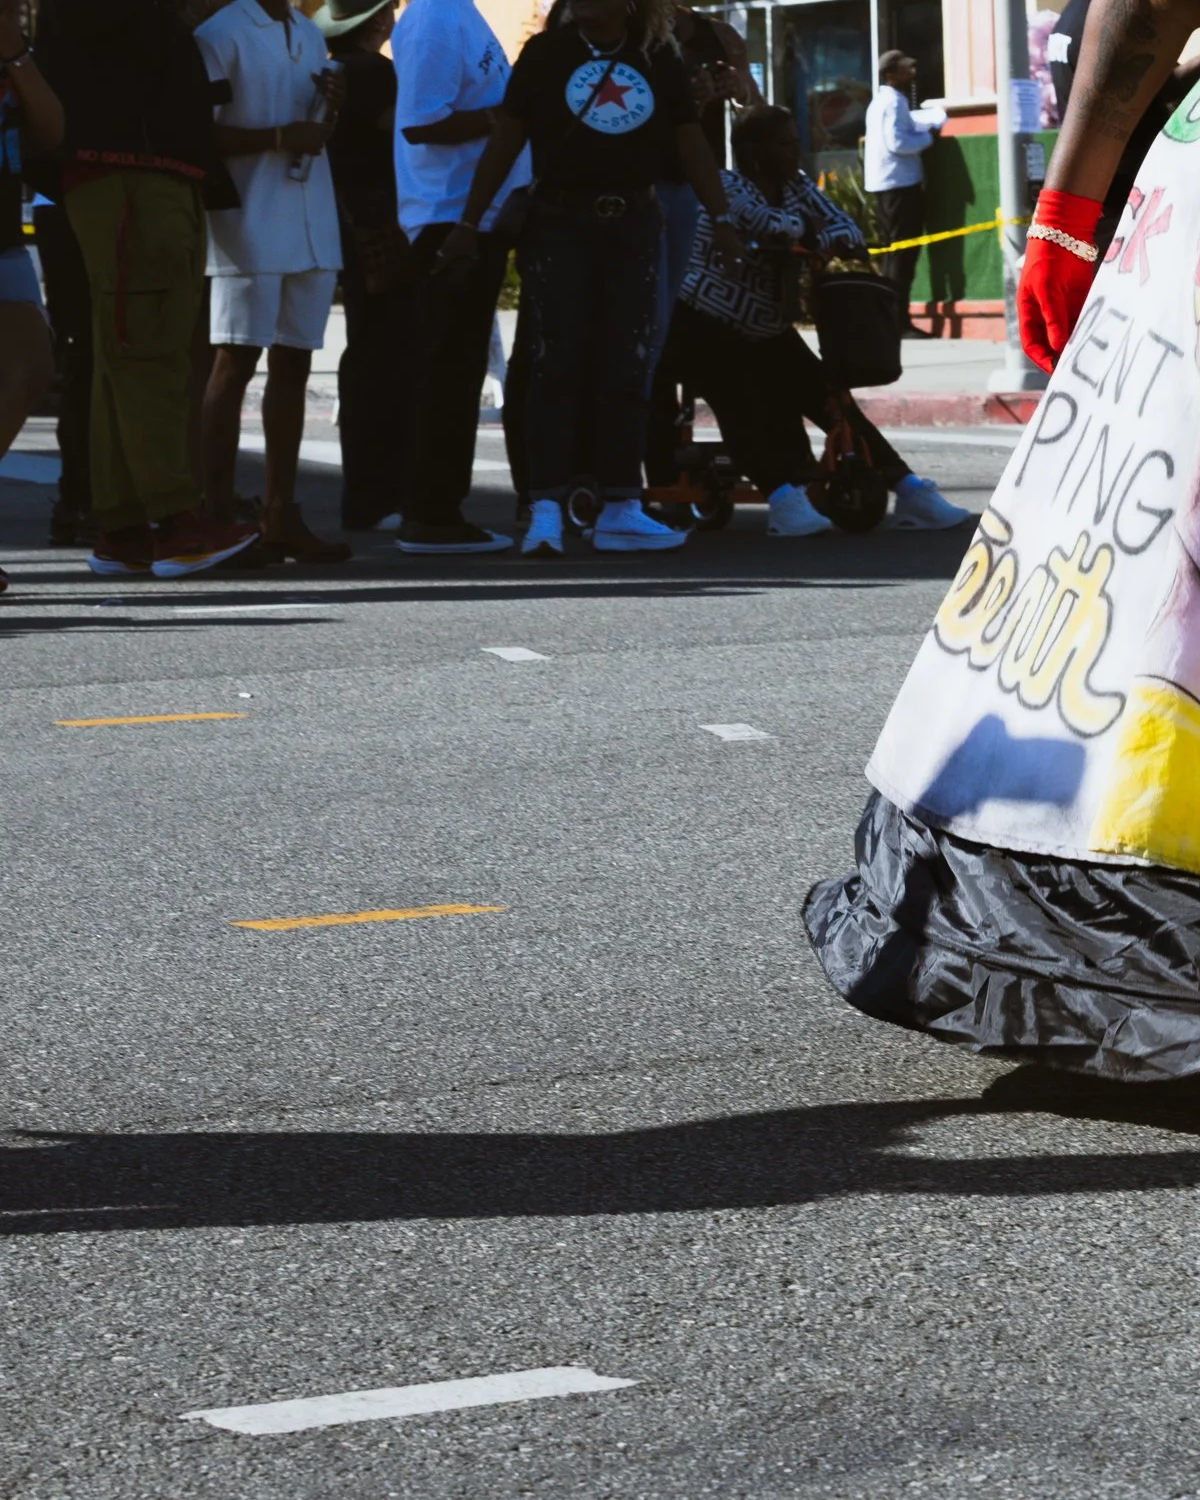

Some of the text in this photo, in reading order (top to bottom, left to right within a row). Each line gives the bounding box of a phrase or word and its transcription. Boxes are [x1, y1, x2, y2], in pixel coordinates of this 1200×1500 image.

[574, 64, 646, 95] CALIFRNIA
[575, 98, 647, 127] AL-STAR
[1015, 390, 1175, 556] PING
